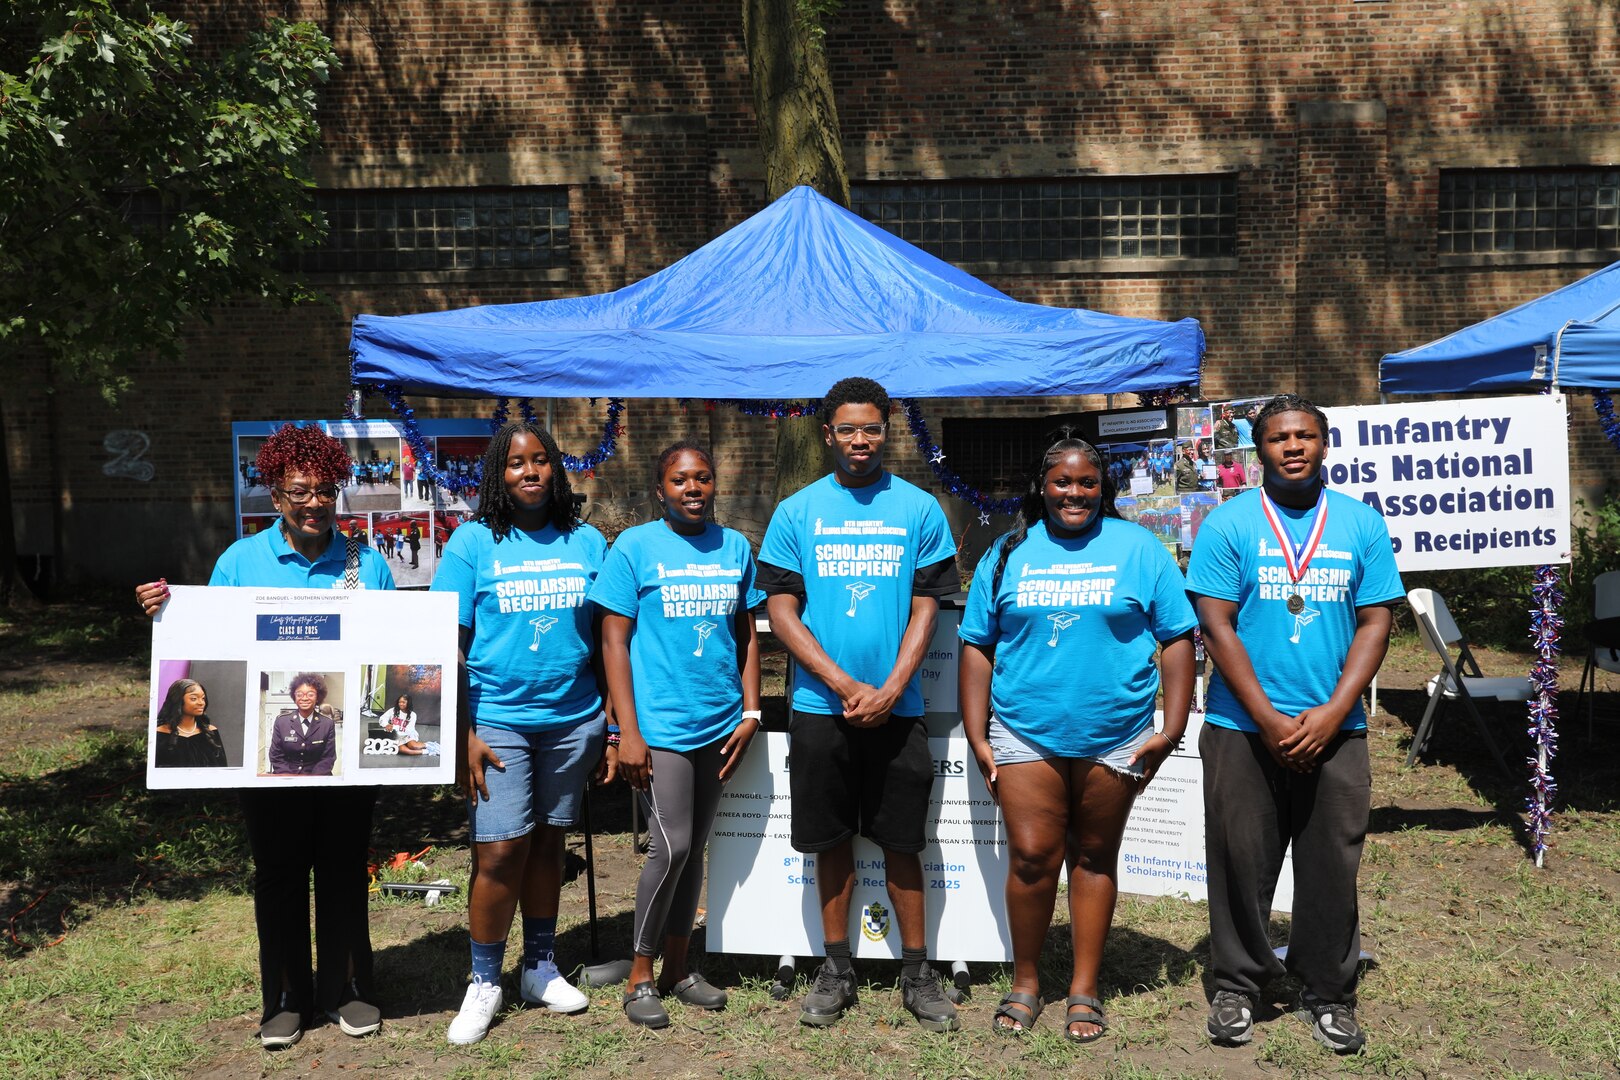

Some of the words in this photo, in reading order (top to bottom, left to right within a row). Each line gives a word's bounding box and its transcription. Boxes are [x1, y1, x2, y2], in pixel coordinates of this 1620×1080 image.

[1357, 414, 1511, 446] Infantry
[1392, 448, 1533, 482] National
[1362, 484, 1554, 517] Association
[1414, 526, 1557, 554] Recipients
[815, 544, 904, 561] SCHOLARSHIP
[817, 561, 901, 577] RECIPIENT
[1258, 566, 1351, 586] SCHARSHIP
[496, 576, 586, 598] SCHOLARSHIP
[1017, 578, 1116, 592] SCHOLARSHIP
[498, 592, 586, 614] RECIPIENT
[1016, 591, 1113, 608] RECIPIENT
[279, 626, 295, 634] CLASS
[297, 626, 302, 634] OF
[305, 626, 318, 634] 2025
[922, 668, 940, 681] Day
[364, 738, 399, 755] 2025
[783, 856, 799, 866] 8th
[924, 861, 965, 872] ciation
[1124, 853, 1140, 862] 8th
[1143, 856, 1181, 869] Infantry
[1126, 865, 1182, 880] Scholarship
[930, 880, 960, 889] 2025
